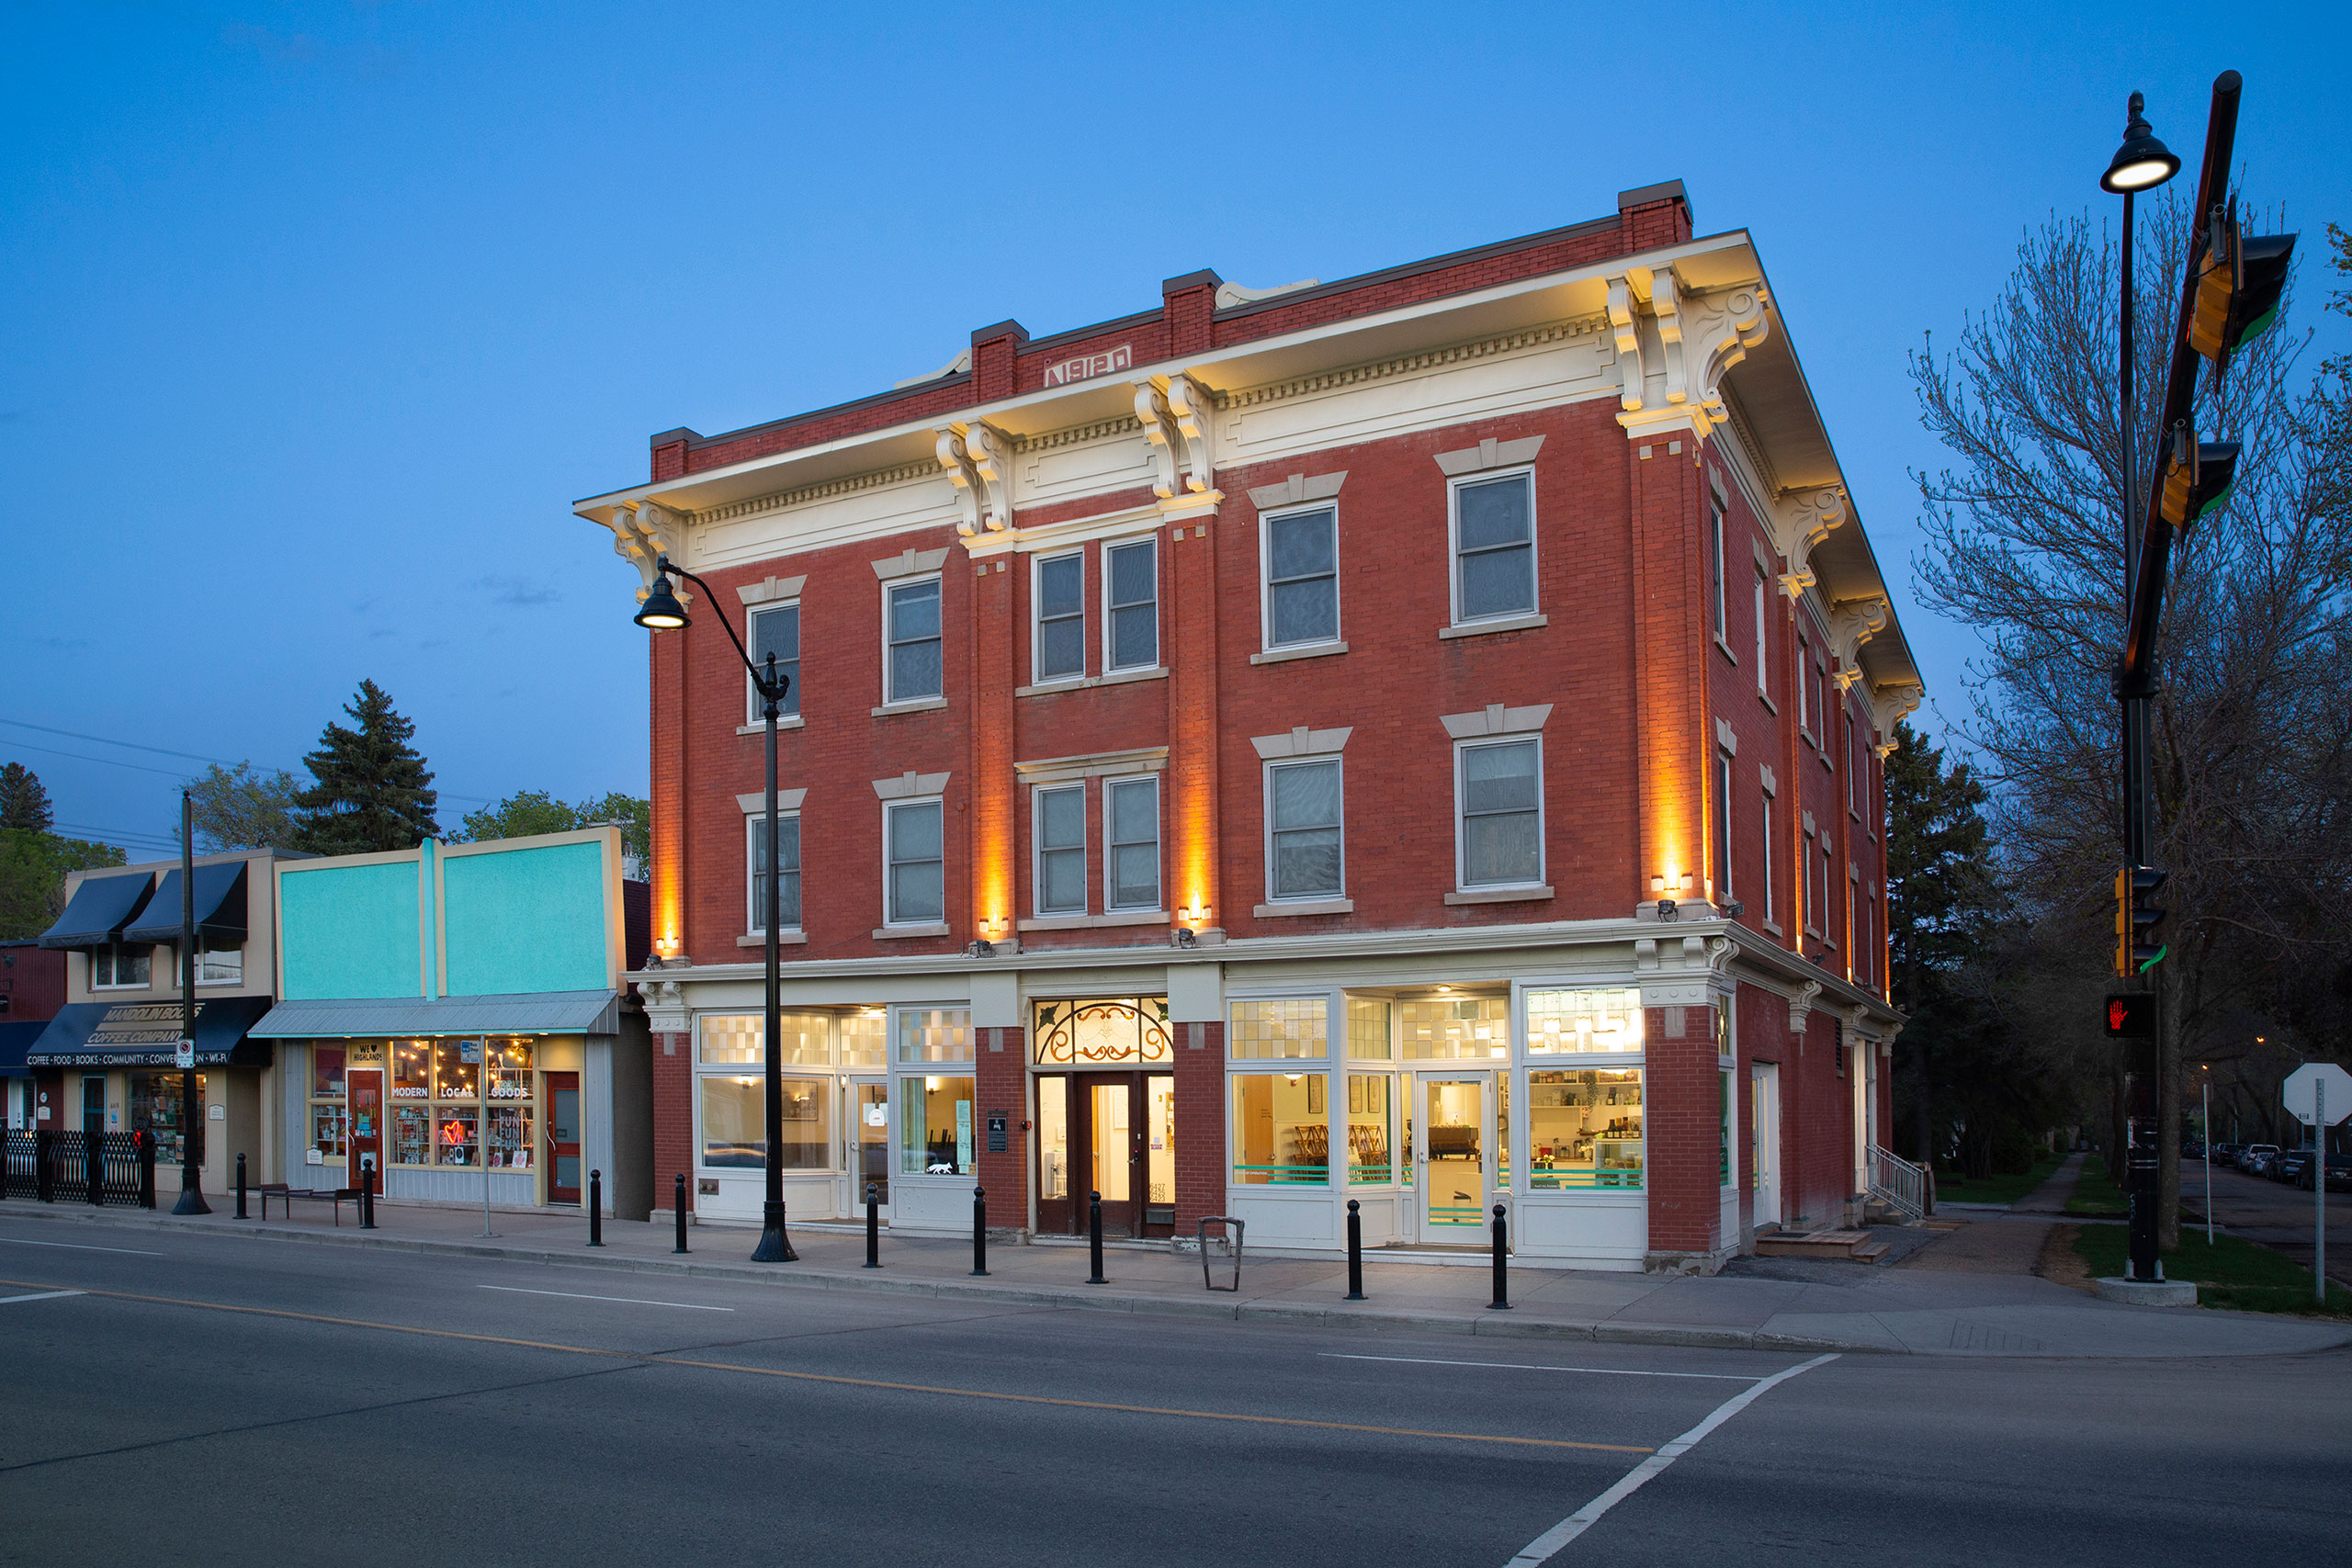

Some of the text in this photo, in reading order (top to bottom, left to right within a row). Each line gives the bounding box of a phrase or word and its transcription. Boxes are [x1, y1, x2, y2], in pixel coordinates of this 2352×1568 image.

[103, 1006, 202, 1021] MANDOLIN BOOS
[87, 1031, 184, 1043] COFFEE COMPANY
[359, 1044, 370, 1054] WE
[27, 1055, 49, 1065] COFFEE
[53, 1055, 72, 1065] FOOD
[76, 1055, 99, 1065] BOOKS
[103, 1055, 145, 1065] COMMUNITY
[353, 1053, 382, 1061] HIGHLANDS
[391, 1087, 528, 1098] MODERN LOCAL GOODS
[499, 1116, 520, 1128] FUN
[499, 1128, 520, 1139] FUN
[499, 1140, 520, 1151] FUN
